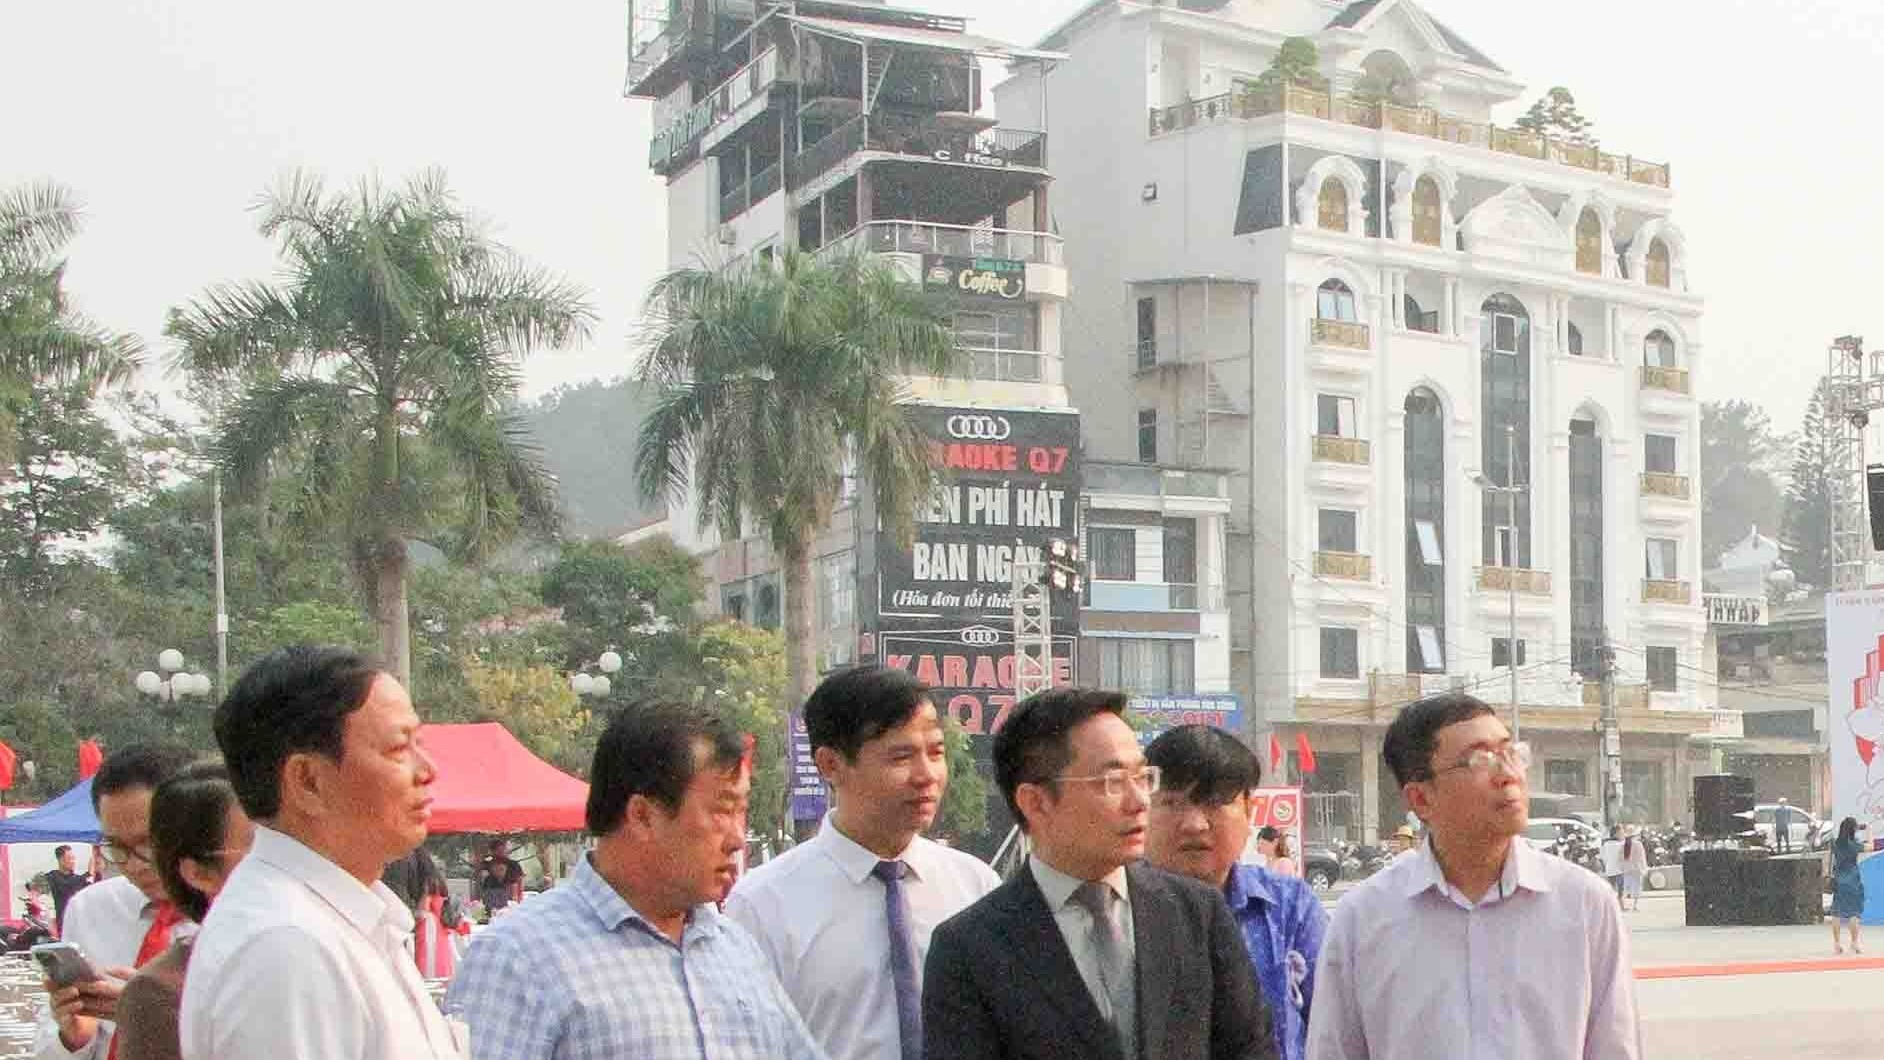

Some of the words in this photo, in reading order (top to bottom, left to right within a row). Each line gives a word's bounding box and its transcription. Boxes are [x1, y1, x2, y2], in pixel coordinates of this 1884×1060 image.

[959, 269, 1010, 295] Coffee
[1029, 447, 1069, 473] Q7
[968, 480, 1010, 525] PHÍ
[1016, 482, 1065, 528] HÁT
[912, 543, 969, 582] BAN
